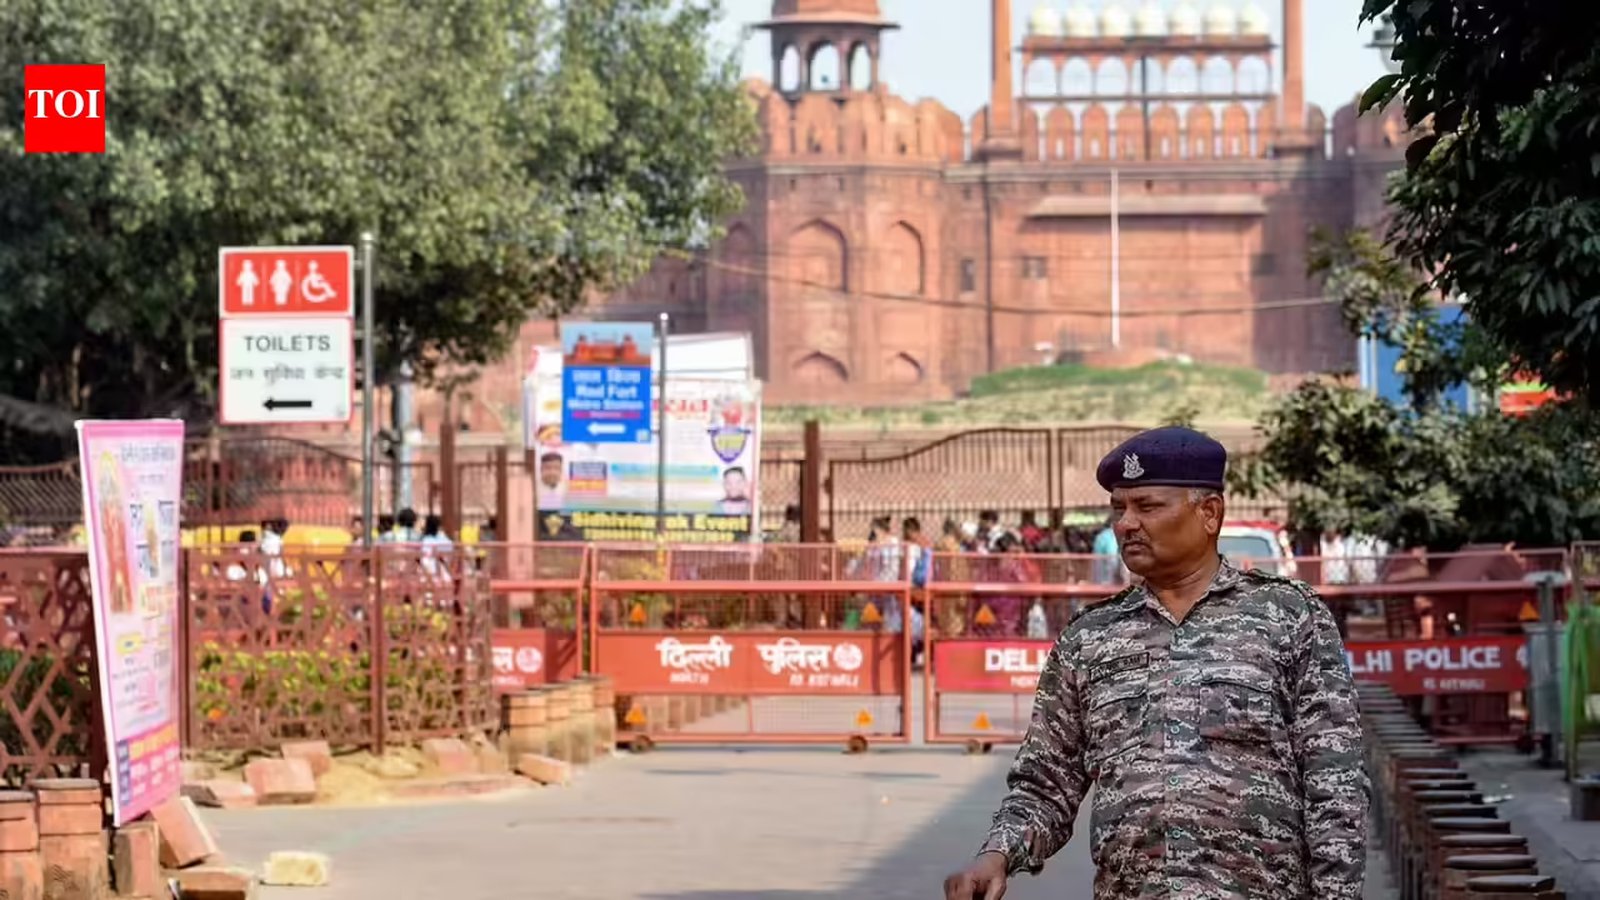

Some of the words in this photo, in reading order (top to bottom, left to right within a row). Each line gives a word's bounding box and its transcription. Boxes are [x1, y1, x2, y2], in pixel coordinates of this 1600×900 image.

[243, 335, 331, 352] TOILETS
[607, 384, 637, 399] Fort
[694, 513, 749, 531] Event
[656, 636, 734, 672] दिल्ली
[756, 637, 832, 675] पुलिस
[1348, 650, 1393, 672] LHI
[1404, 646, 1501, 672] POLICE
